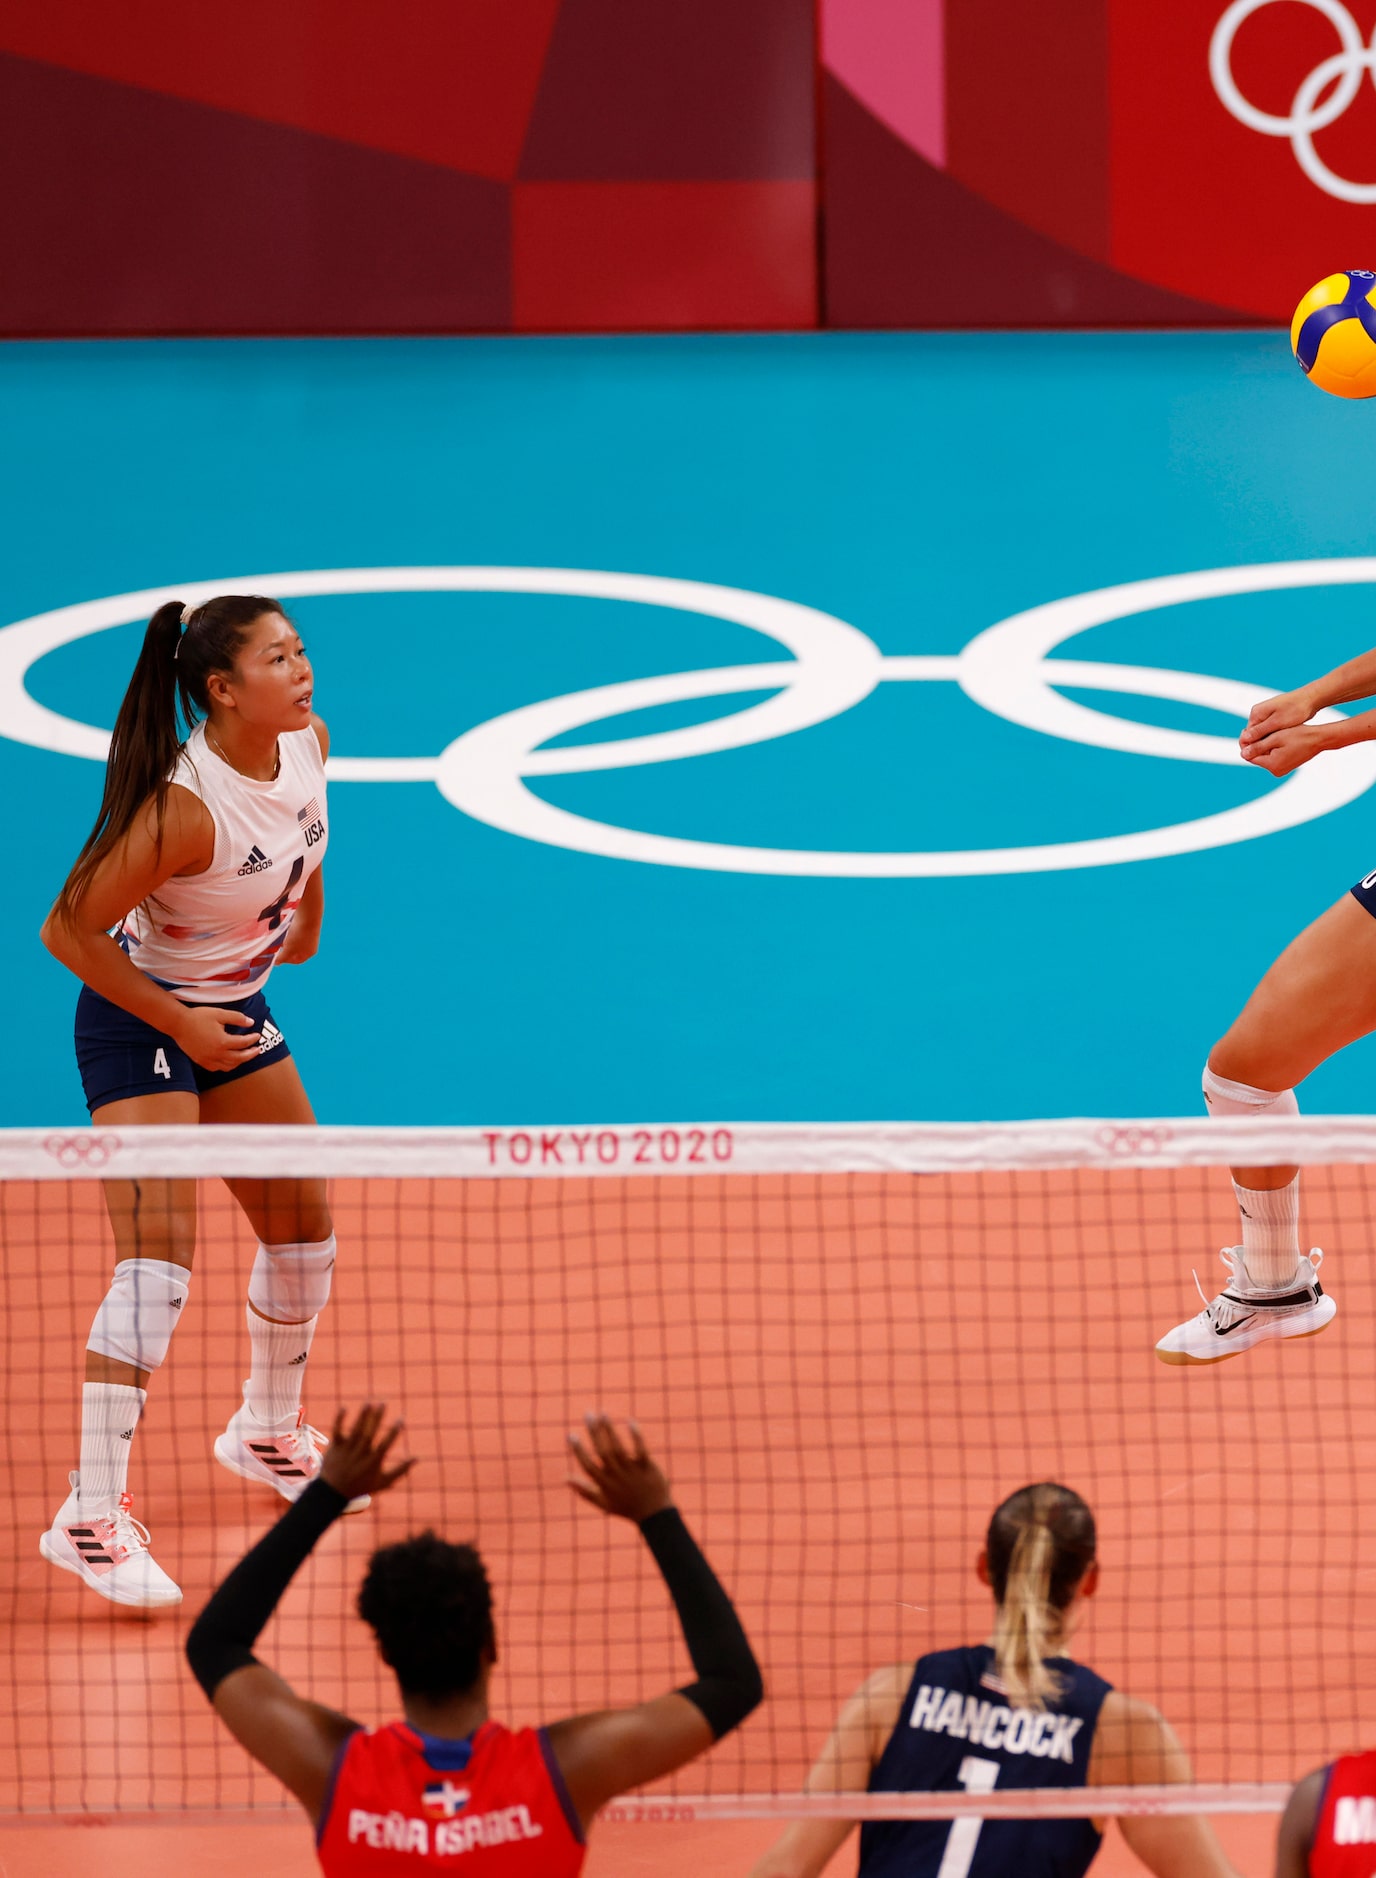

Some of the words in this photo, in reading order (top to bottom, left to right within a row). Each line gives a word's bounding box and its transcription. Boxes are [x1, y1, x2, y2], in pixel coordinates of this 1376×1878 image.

[304, 820, 325, 847] USA
[237, 859, 273, 877] adidas
[257, 855, 304, 931] 4
[258, 1032, 285, 1055] adida
[153, 1047, 171, 1079] 4
[482, 1132, 620, 1165] TOKYO
[632, 1129, 734, 1164] 2020
[909, 1684, 1085, 1765] HANCOCK
[348, 1808, 430, 1856] PEÑA
[435, 1804, 544, 1857] ISABEL
[935, 1755, 1000, 1878] 1
